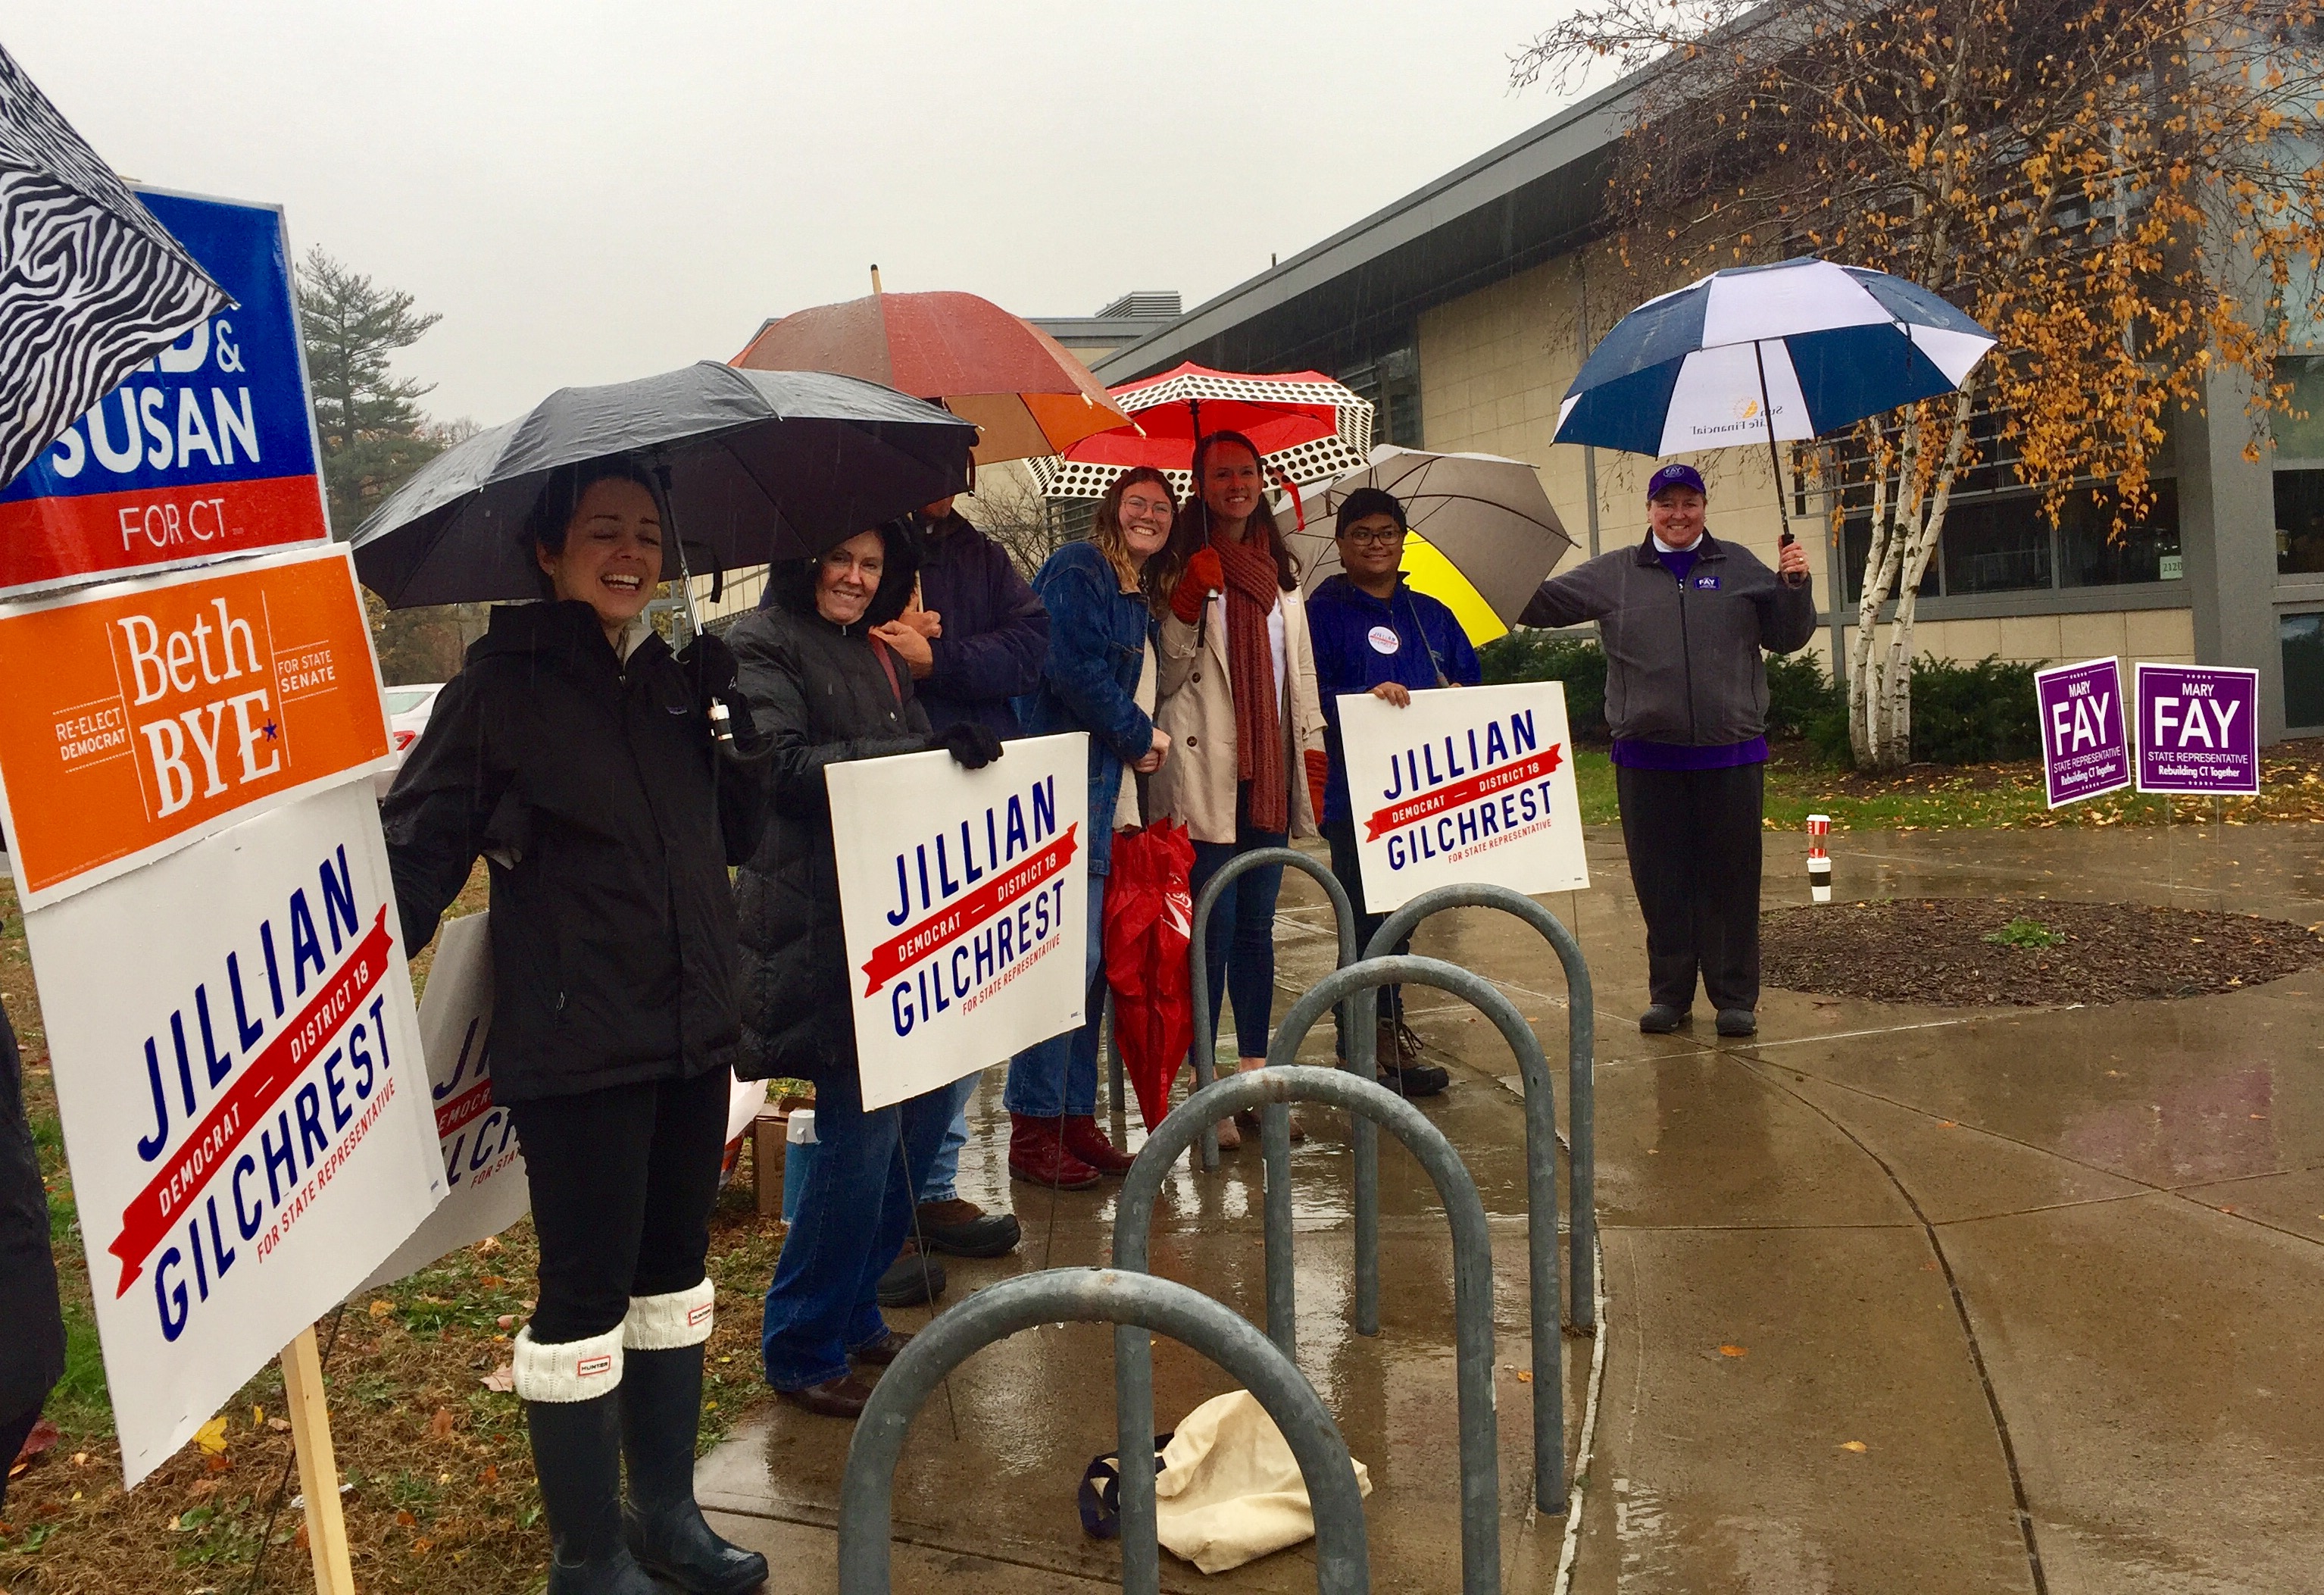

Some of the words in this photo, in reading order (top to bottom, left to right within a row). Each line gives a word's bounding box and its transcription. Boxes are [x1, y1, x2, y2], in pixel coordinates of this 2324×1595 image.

[216, 319, 245, 373] &
[119, 503, 183, 551] FOR
[189, 498, 225, 540] CT
[117, 598, 262, 706] Beth
[277, 658, 299, 675] FOR
[301, 650, 333, 669] STATE
[281, 666, 336, 693] SENATE
[2069, 680, 2091, 698] MARY
[2182, 683, 2215, 696] MARY
[55, 708, 121, 742] RE-ELECT
[60, 728, 125, 761] DEMOCRAT
[2052, 692, 2110, 756] FAY
[2154, 696, 2241, 749] FAY
[140, 688, 281, 820] BYE
[1383, 708, 1537, 800] JILLIAN
[2054, 759, 2072, 773] STATE
[2072, 746, 2121, 768] REPRESENTATIVE
[2060, 770, 2088, 786] Rebuilding
[2088, 767, 2095, 778] CT
[2095, 762, 2116, 777] Together
[2148, 751, 2175, 762] STATE
[2176, 752, 2248, 764] REPRESENTATIVE
[2158, 764, 2198, 779] Rebuilding
[2199, 766, 2209, 777] CT
[2210, 765, 2240, 780] Together
[1392, 795, 1445, 823] DEMOCRAT
[1479, 767, 1523, 792] DISTRICT
[1527, 762, 1539, 775] 18
[887, 774, 1057, 927] JILLIAN
[1387, 780, 1551, 871] GILCHREST
[1448, 850, 1463, 864] FOR
[1464, 842, 1487, 858] STATE
[1488, 818, 1552, 849] REPRESENTATIVE
[898, 911, 961, 962] DEMOCRAT
[998, 860, 1042, 902] DISTRICT
[1045, 852, 1057, 871] 18
[892, 877, 1064, 1037] GILCHREST
[963, 995, 977, 1015] FOR
[979, 977, 1001, 1003] STATE
[1003, 934, 1061, 986] REPRESENTATIVE
[137, 843, 360, 1162] JILLIAN
[158, 1102, 242, 1218] DEMOCRAT
[290, 979, 351, 1064] DISTRICT
[352, 960, 370, 990] 18
[155, 993, 390, 1342] GILCHREST
[257, 1226, 280, 1264] FOR
[283, 1179, 317, 1234] STATE
[317, 1077, 395, 1191] REPRESENTATIVE
[470, 1165, 494, 1189] FOR
[692, 1309, 711, 1321] HUNTER
[581, 1361, 608, 1371] HUNTER
